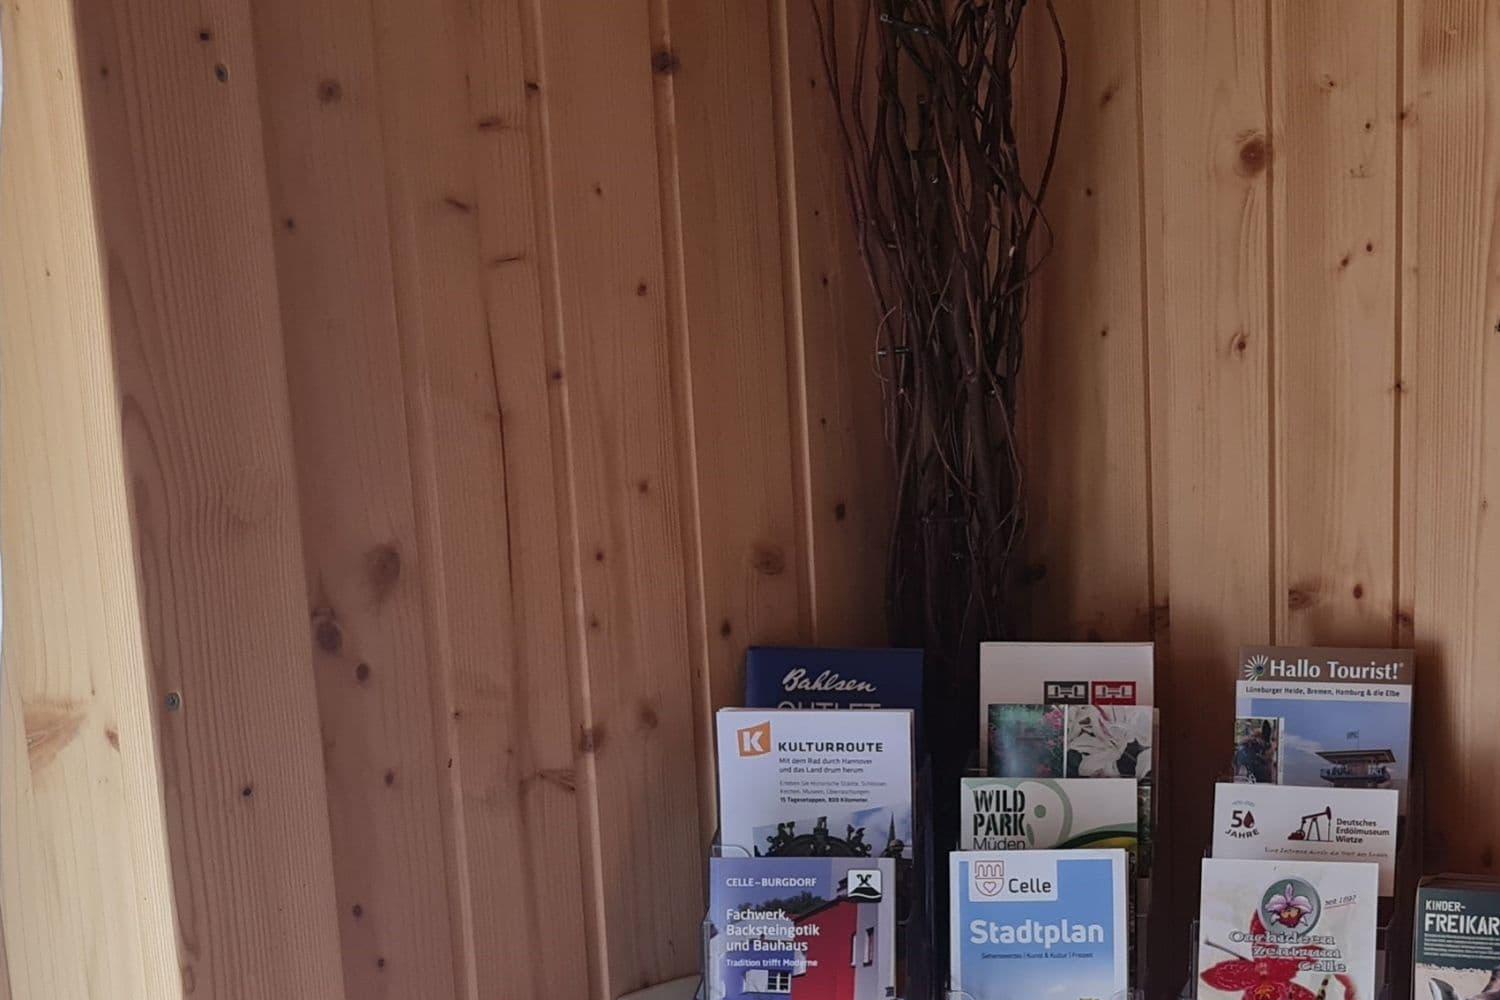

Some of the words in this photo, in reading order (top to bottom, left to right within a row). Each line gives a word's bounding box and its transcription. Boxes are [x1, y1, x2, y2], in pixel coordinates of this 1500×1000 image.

[1270, 659, 1321, 678] Hallo
[1327, 661, 1399, 680] Tourist!
[782, 668, 877, 692] Bahlsen
[1245, 687, 1282, 695] Lüneburger
[1335, 689, 1365, 697] Hamburg
[1385, 689, 1400, 697] Elbe
[778, 742, 884, 752] KULTURROUTE
[973, 790, 1026, 812] WILD
[973, 813, 1026, 836] PARK
[1337, 818, 1377, 827] Deutsches
[1225, 828, 1260, 839] JAHRE
[1336, 827, 1390, 836] Erdölmuseum
[973, 837, 1026, 850] Müden
[1335, 835, 1363, 844] Wietze
[1008, 878, 1052, 893] Celle
[1425, 900, 1466, 912] KINDER-
[726, 908, 790, 921] Fachwerk,
[726, 924, 820, 939] Backsteingotik
[969, 919, 1105, 949] Stadtplan
[1228, 930, 1335, 945] Orchideen
[726, 940, 750, 951] und
[753, 940, 809, 951] Bauhaus
[726, 958, 761, 967] Tradition
[762, 958, 781, 967] trifft
[782, 959, 818, 967] Moderne
[1298, 960, 1347, 972] Celle
